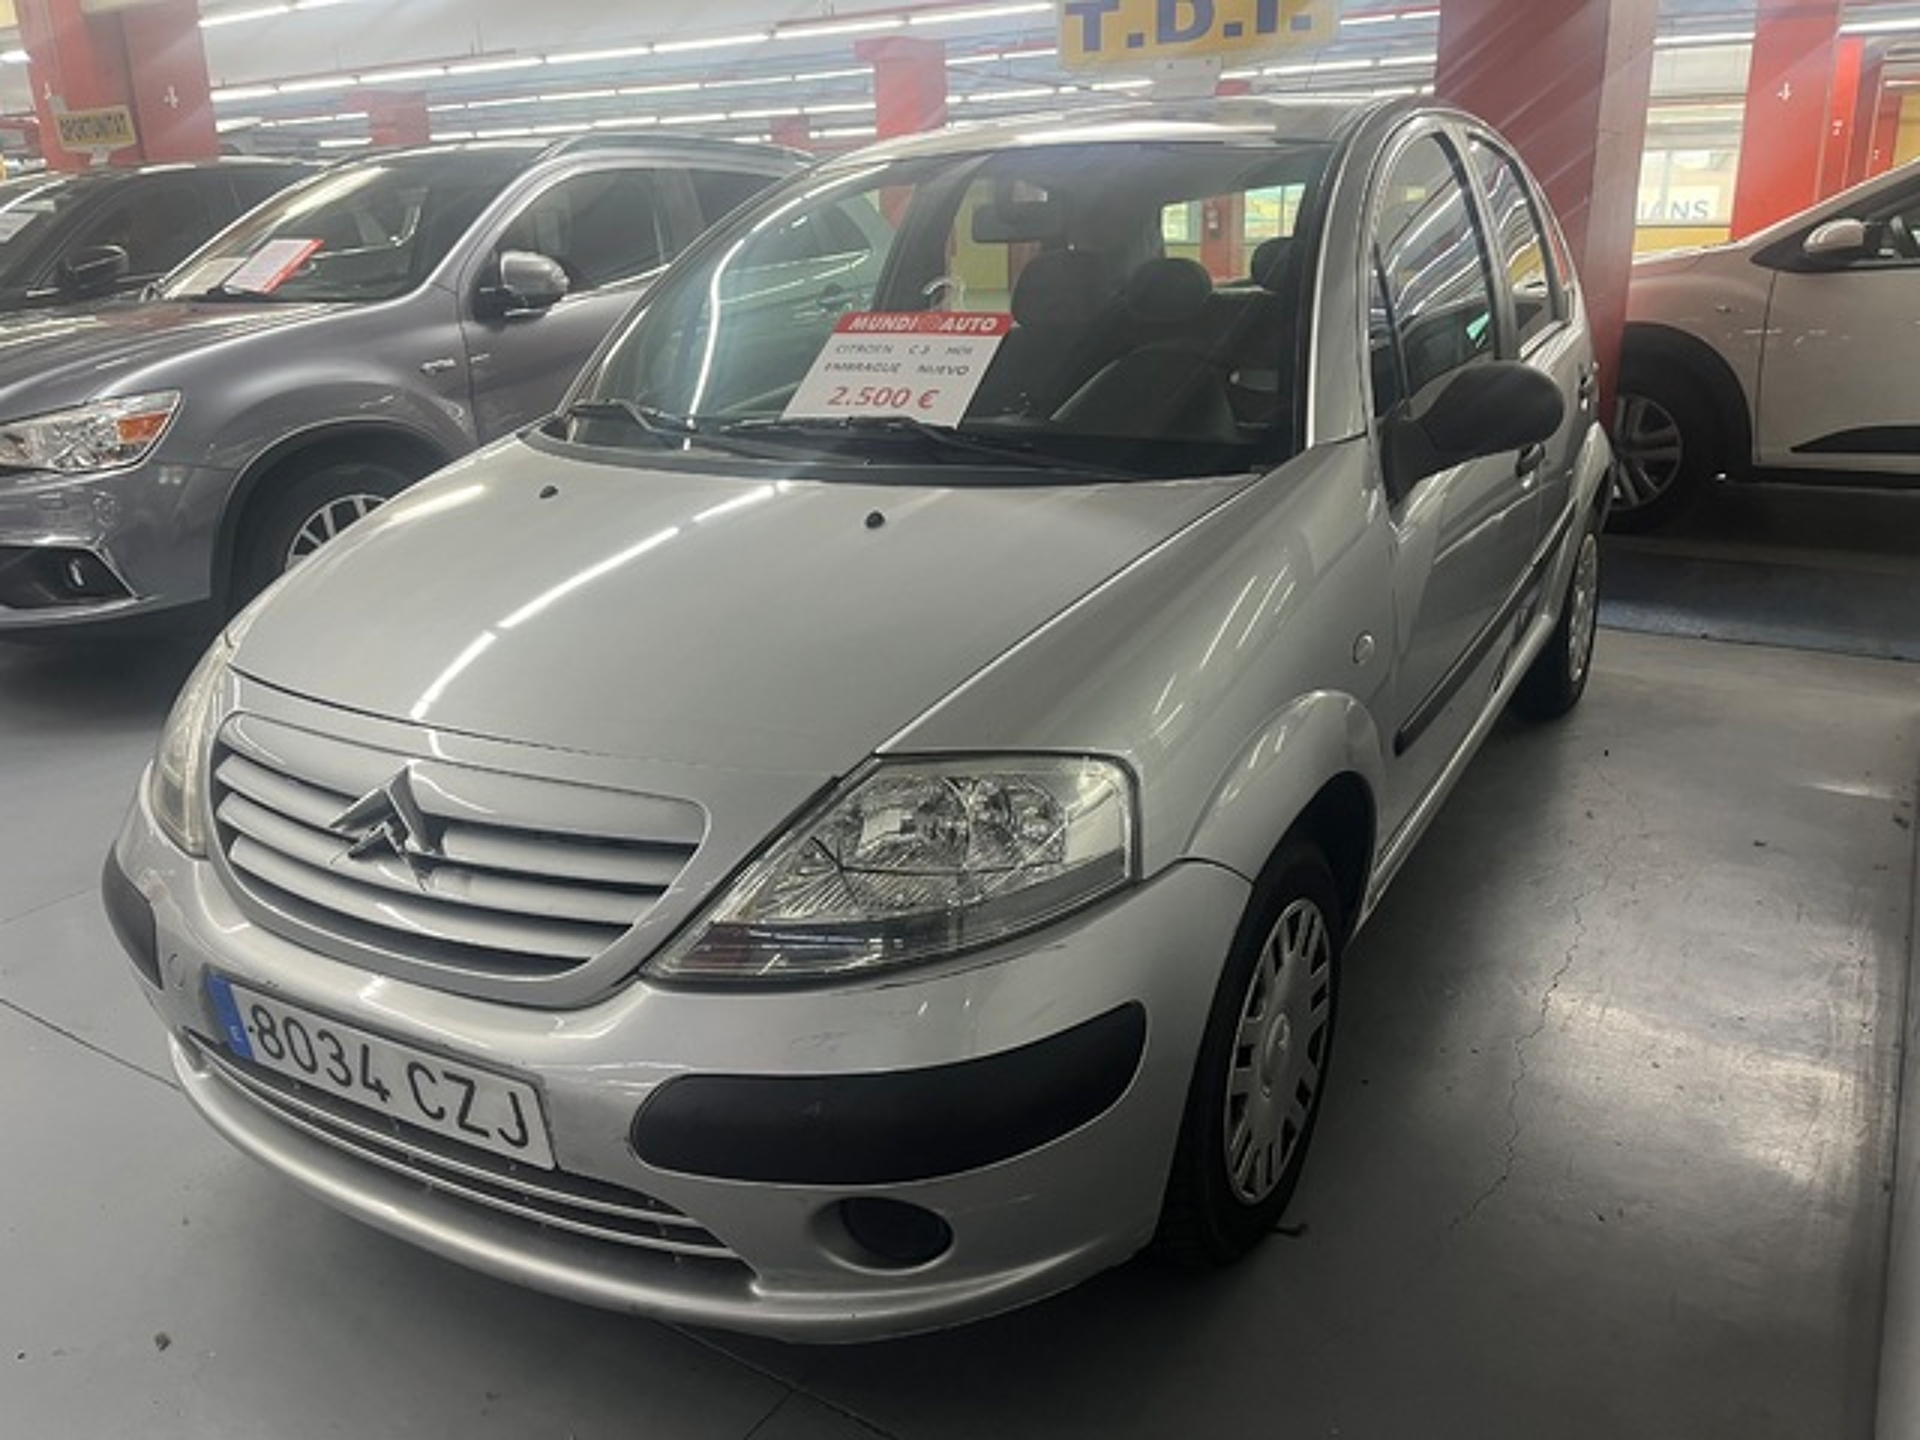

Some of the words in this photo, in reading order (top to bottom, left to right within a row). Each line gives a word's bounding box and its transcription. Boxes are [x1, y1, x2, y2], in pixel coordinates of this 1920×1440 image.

[1064, 0, 1311, 52] T.D.I.
[849, 315, 917, 331] MUNDI
[939, 317, 998, 332] AUTO
[916, 363, 970, 376] NUEVO
[827, 386, 912, 408] 2.500
[917, 388, 940, 409] €
[251, 1004, 392, 1102] 8034
[407, 1061, 530, 1148] CZJ
